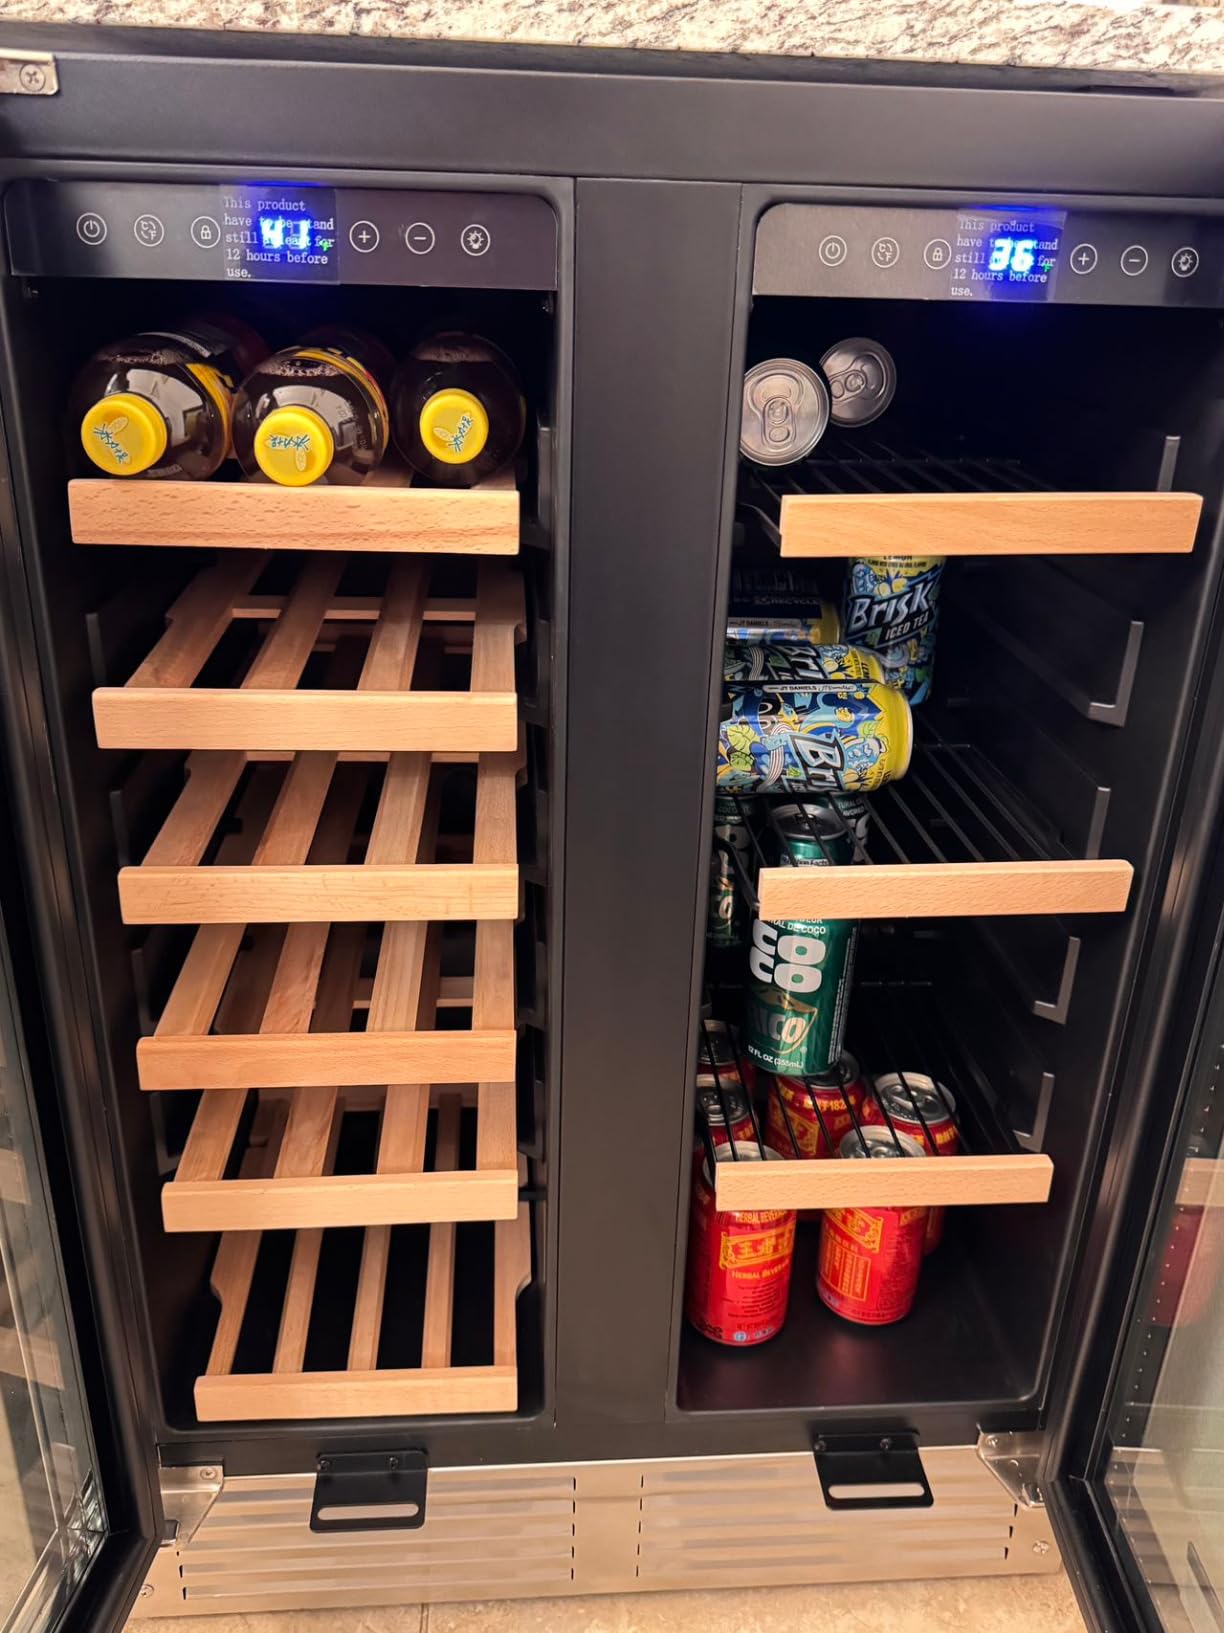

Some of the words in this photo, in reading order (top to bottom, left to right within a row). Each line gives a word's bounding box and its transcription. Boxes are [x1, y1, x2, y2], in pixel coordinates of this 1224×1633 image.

[224, 196, 251, 209] This
[258, 198, 306, 212] product
[224, 213, 252, 226] have
[305, 218, 334, 230] tand
[960, 217, 984, 230] This
[990, 220, 1035, 233] product
[225, 231, 259, 244] still
[957, 234, 982, 247] have
[1032, 238, 1058, 250] tand
[226, 248, 240, 260] 12
[246, 249, 281, 262] hours
[287, 250, 328, 264] before
[954, 252, 985, 264] still
[1037, 255, 1057, 267] for
[226, 267, 252, 278] use.
[953, 268, 966, 279] 12
[971, 269, 1003, 281] hours
[1009, 270, 1048, 283] before
[951, 286, 973, 296] use.
[885, 621, 911, 641] ICED
[913, 610, 929, 630] TEA
